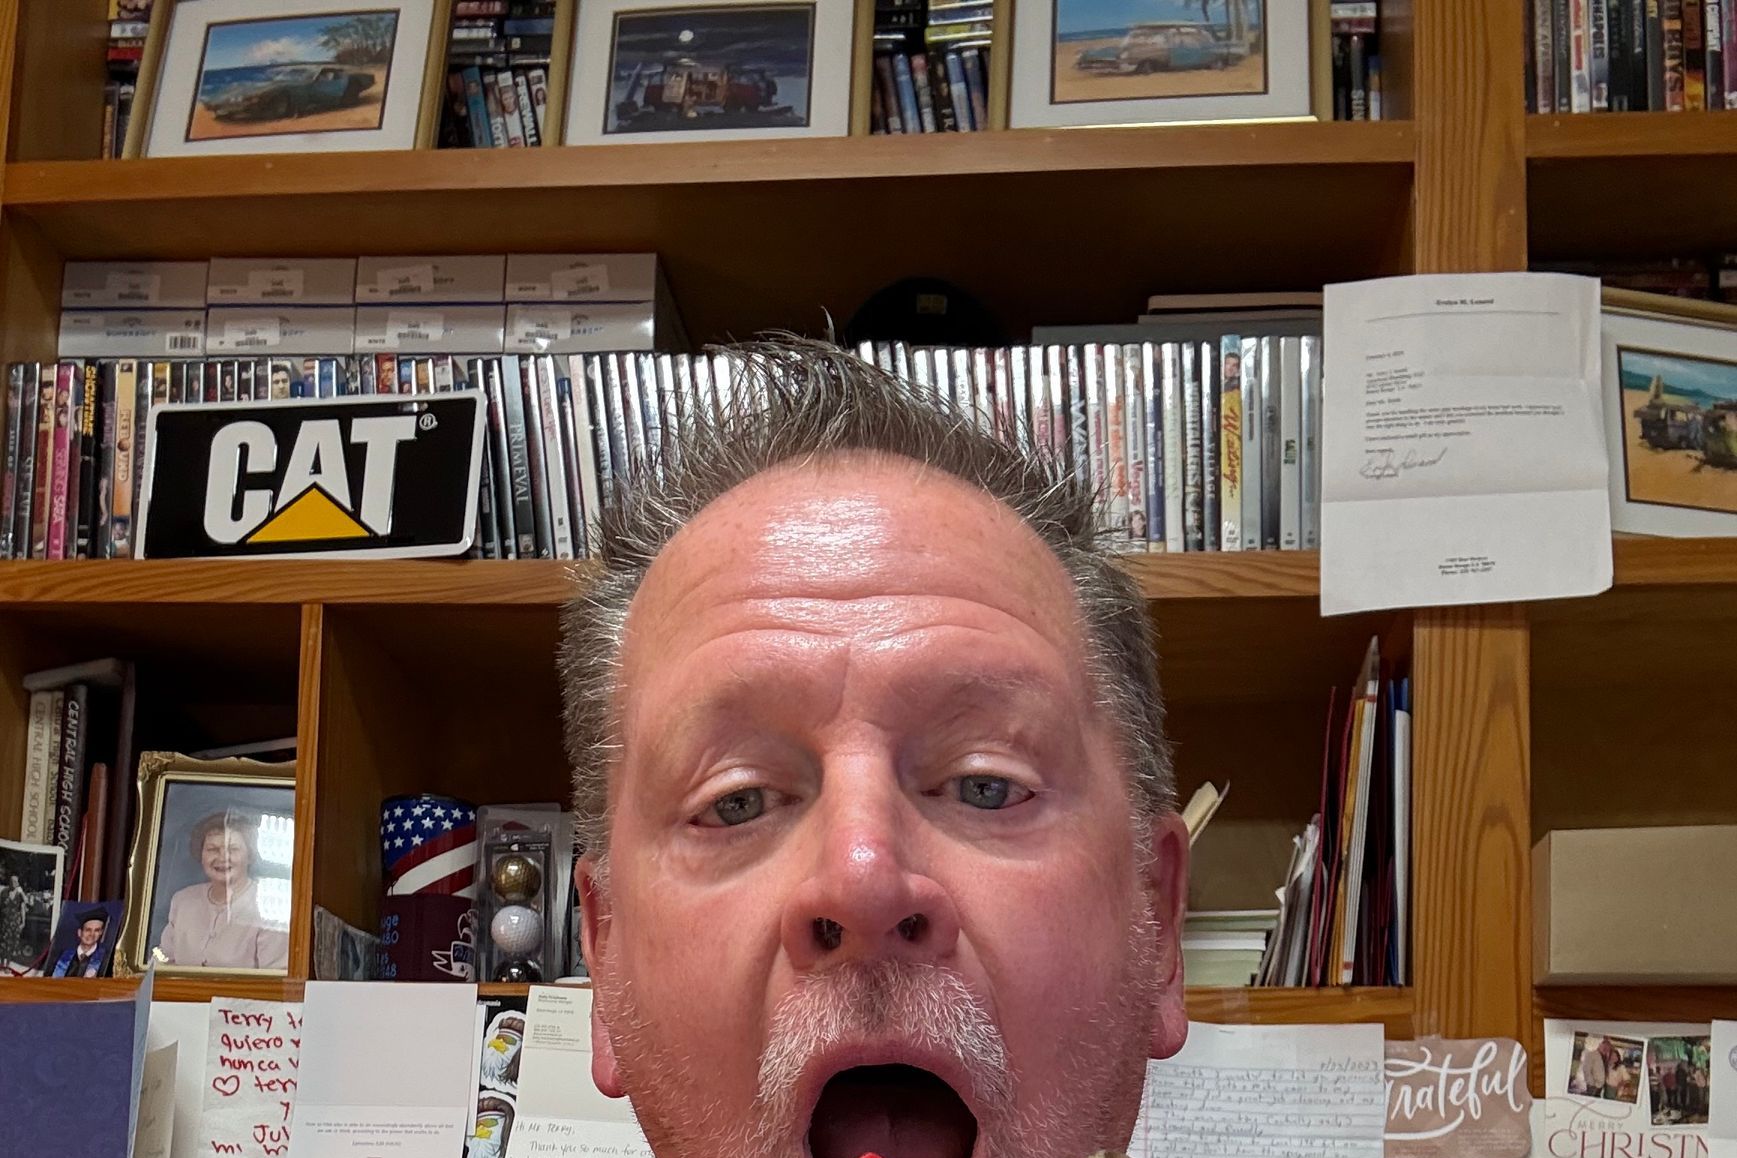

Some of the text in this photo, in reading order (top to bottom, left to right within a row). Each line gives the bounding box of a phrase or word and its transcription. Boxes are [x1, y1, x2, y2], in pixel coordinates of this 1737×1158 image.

[515, 75, 538, 147] FIREWALL
[82, 365, 98, 437] SHOWTIME
[116, 408, 132, 482] REBOUND
[203, 415, 418, 545] CAT
[63, 700, 80, 763] CENTRAL
[26, 701, 46, 841] CENTRAL HIGH SCHOOL
[60, 766, 75, 801] HIGH
[218, 1009, 272, 1033] Terry
[221, 1033, 283, 1053] quiero
[220, 1055, 280, 1073] nunca
[1384, 1041, 1528, 1121] rateful
[1577, 1119, 1625, 1131] MERRY
